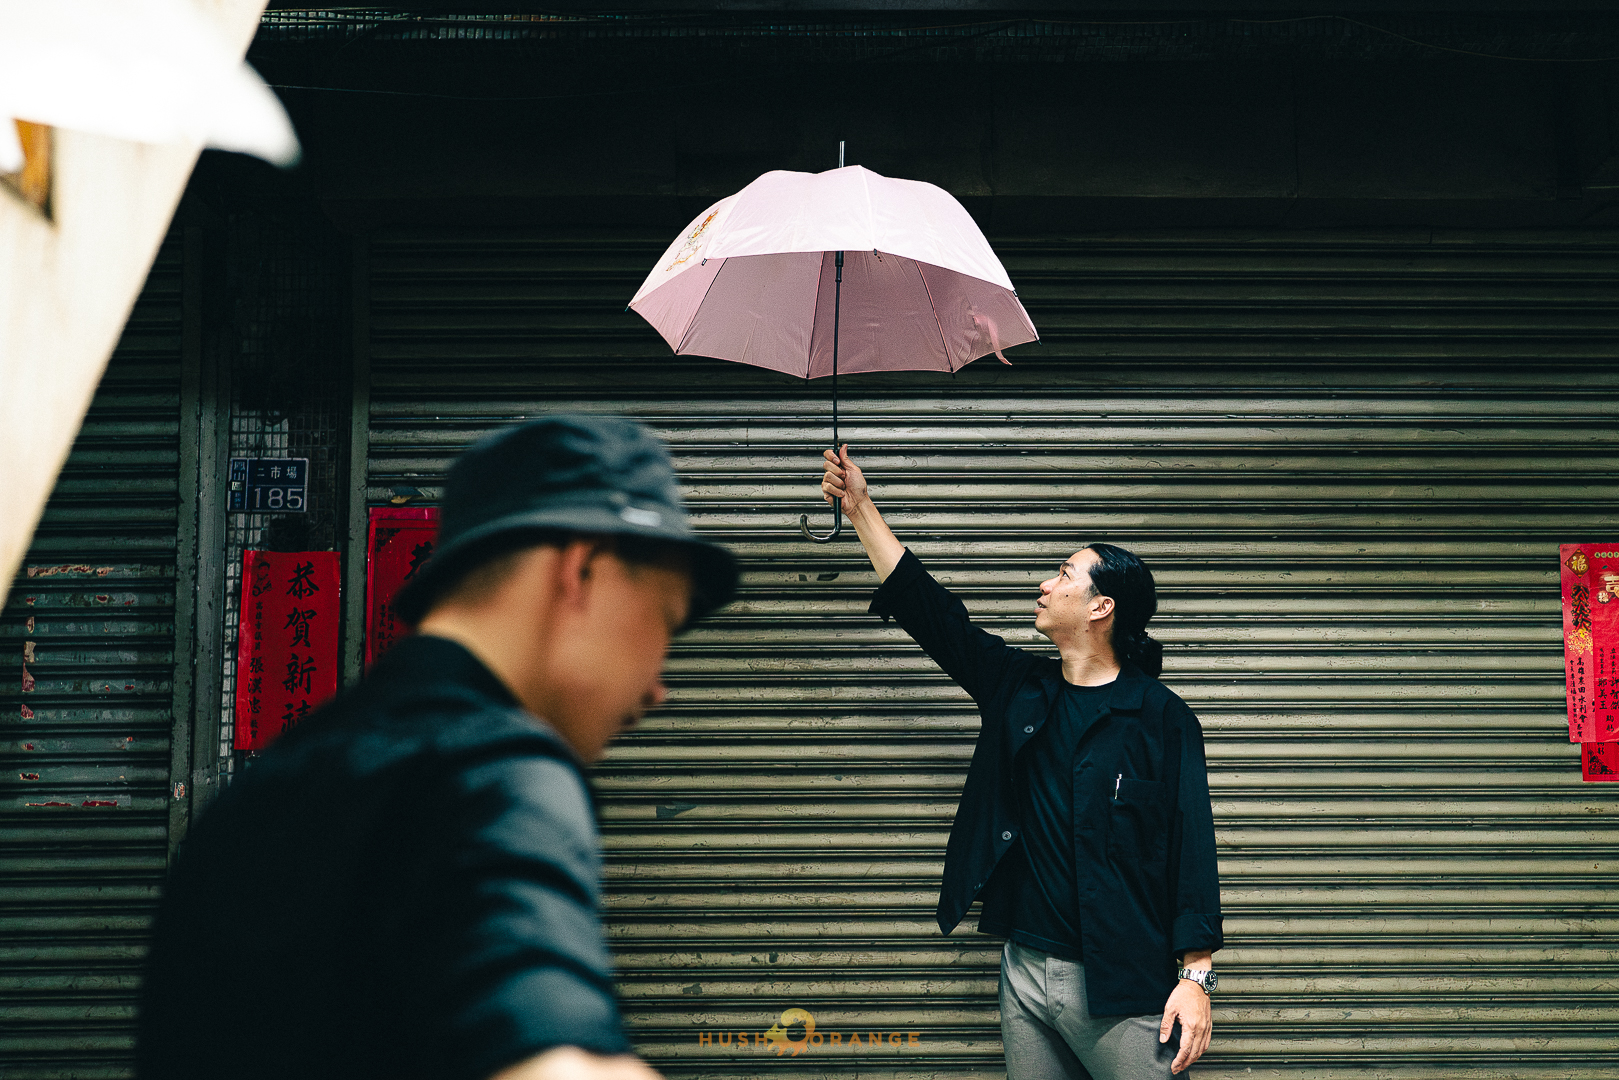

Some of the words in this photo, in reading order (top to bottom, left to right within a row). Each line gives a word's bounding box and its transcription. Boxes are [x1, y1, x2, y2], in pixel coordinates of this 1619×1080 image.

[257, 465, 297, 479] 二市場
[254, 487, 303, 509] 185
[1571, 554, 1588, 572] 福
[248, 656, 264, 714] 張漢忠
